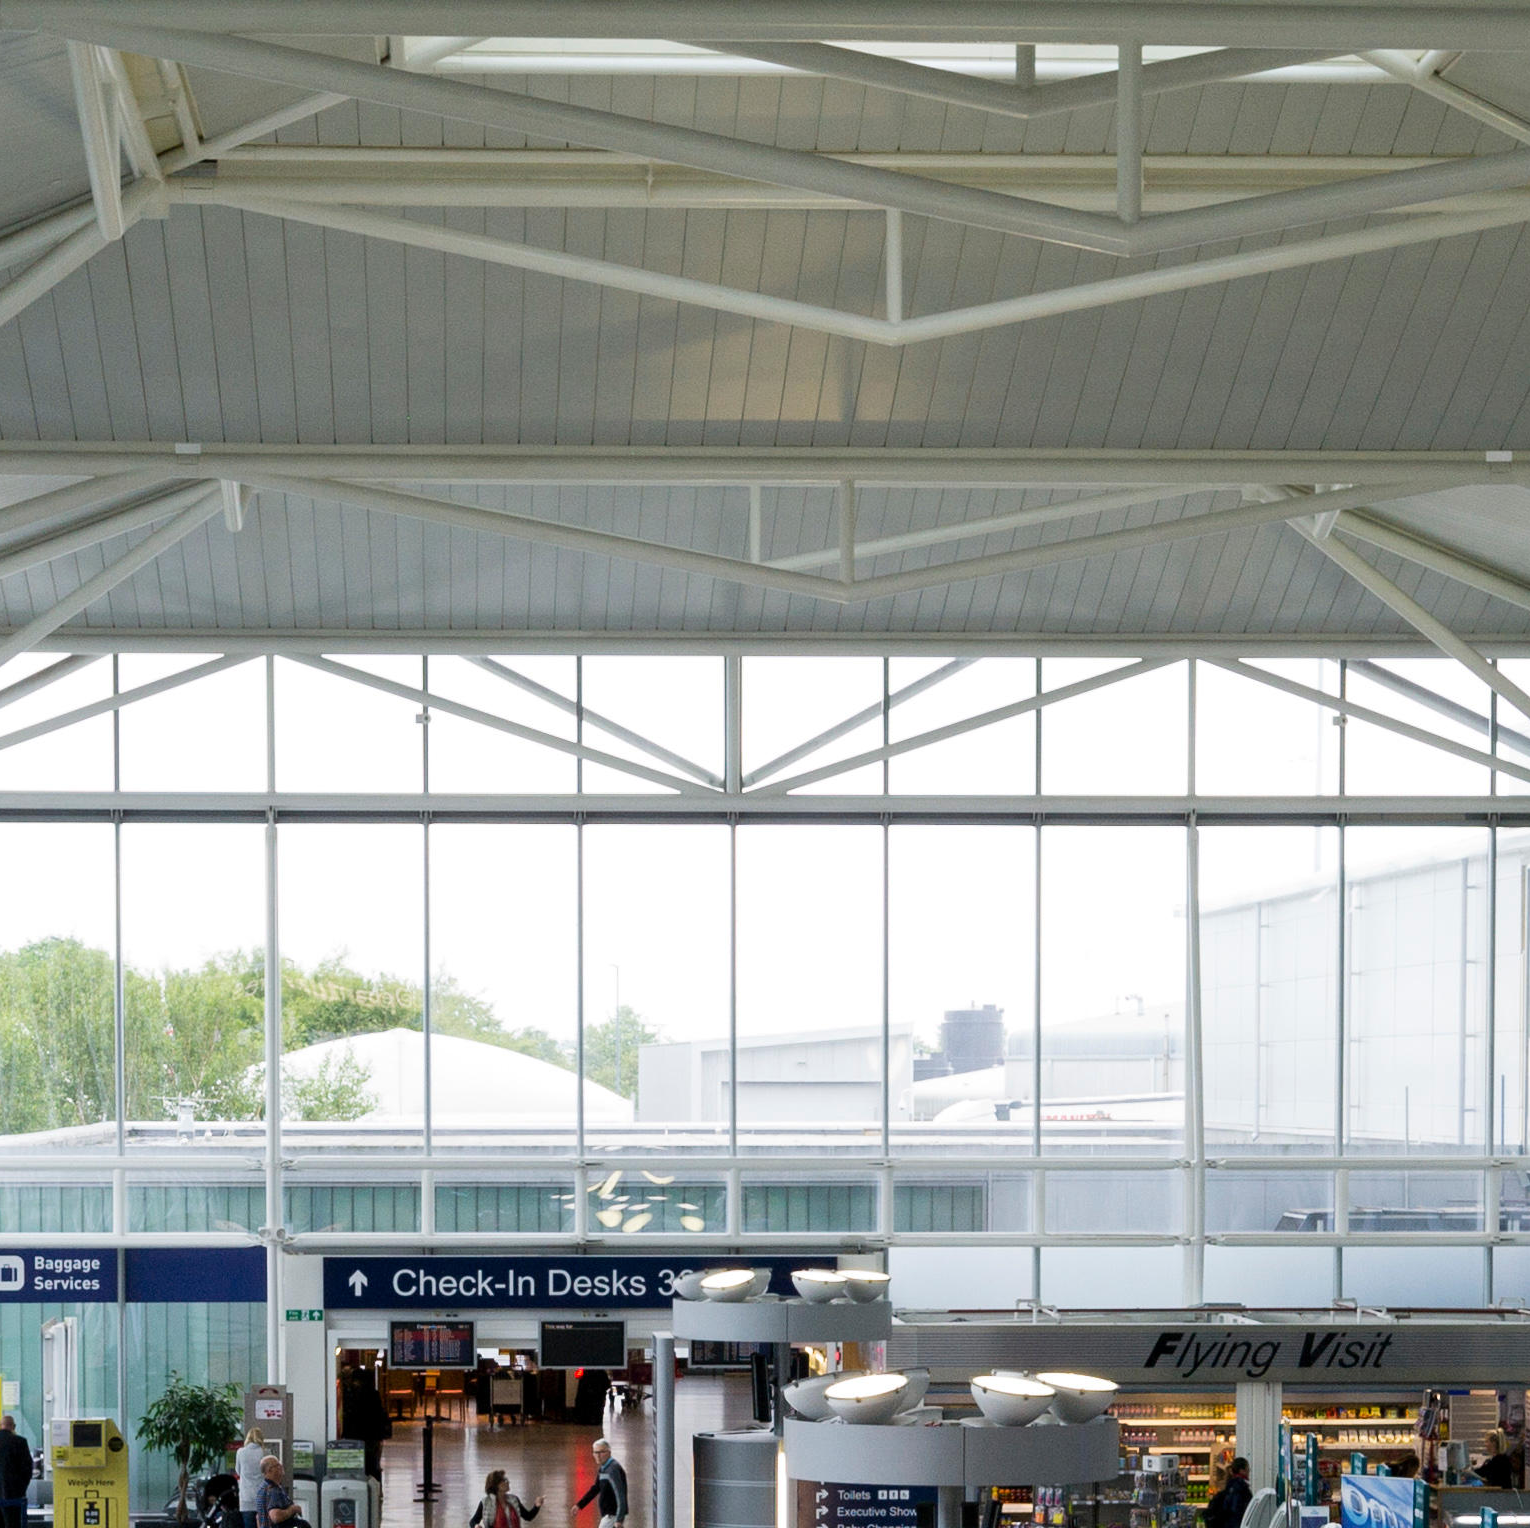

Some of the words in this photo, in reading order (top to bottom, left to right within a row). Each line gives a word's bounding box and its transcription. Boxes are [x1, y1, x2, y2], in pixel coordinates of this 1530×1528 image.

[34, 1256, 100, 1272] Baggage
[34, 1277, 100, 1291] Services
[392, 1268, 535, 1297] Check-In
[548, 1268, 647, 1297] Desks
[1143, 1332, 1282, 1378] Flying
[1298, 1332, 1394, 1368] Visit
[68, 1479, 94, 1488] Weigh
[838, 1489, 871, 1500] Toilets
[837, 1507, 886, 1517] Executive
